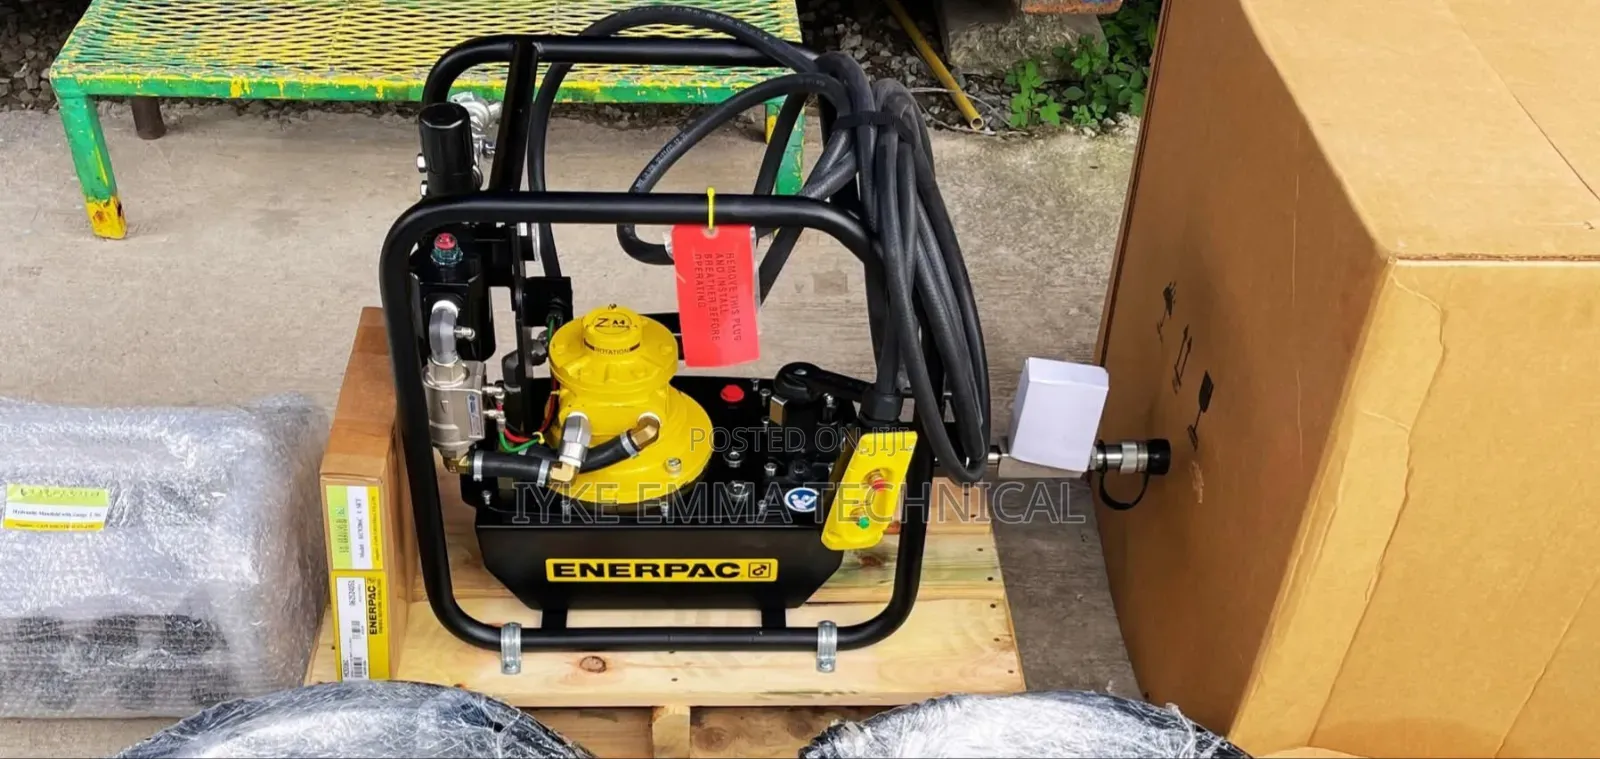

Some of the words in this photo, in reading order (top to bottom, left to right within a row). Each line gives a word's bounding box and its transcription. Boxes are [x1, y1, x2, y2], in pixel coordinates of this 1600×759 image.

[694, 253, 706, 308] OPERATING
[704, 253, 717, 303] BREATHER
[715, 253, 725, 273] AND
[725, 252, 738, 293] REMOVE
[717, 277, 729, 315] INSTALL
[729, 295, 740, 316] THIS
[708, 307, 720, 341] BEFORE
[732, 318, 742, 341] PLUG
[552, 562, 741, 578] ENERPAC
[367, 585, 377, 635] ENERPAC
